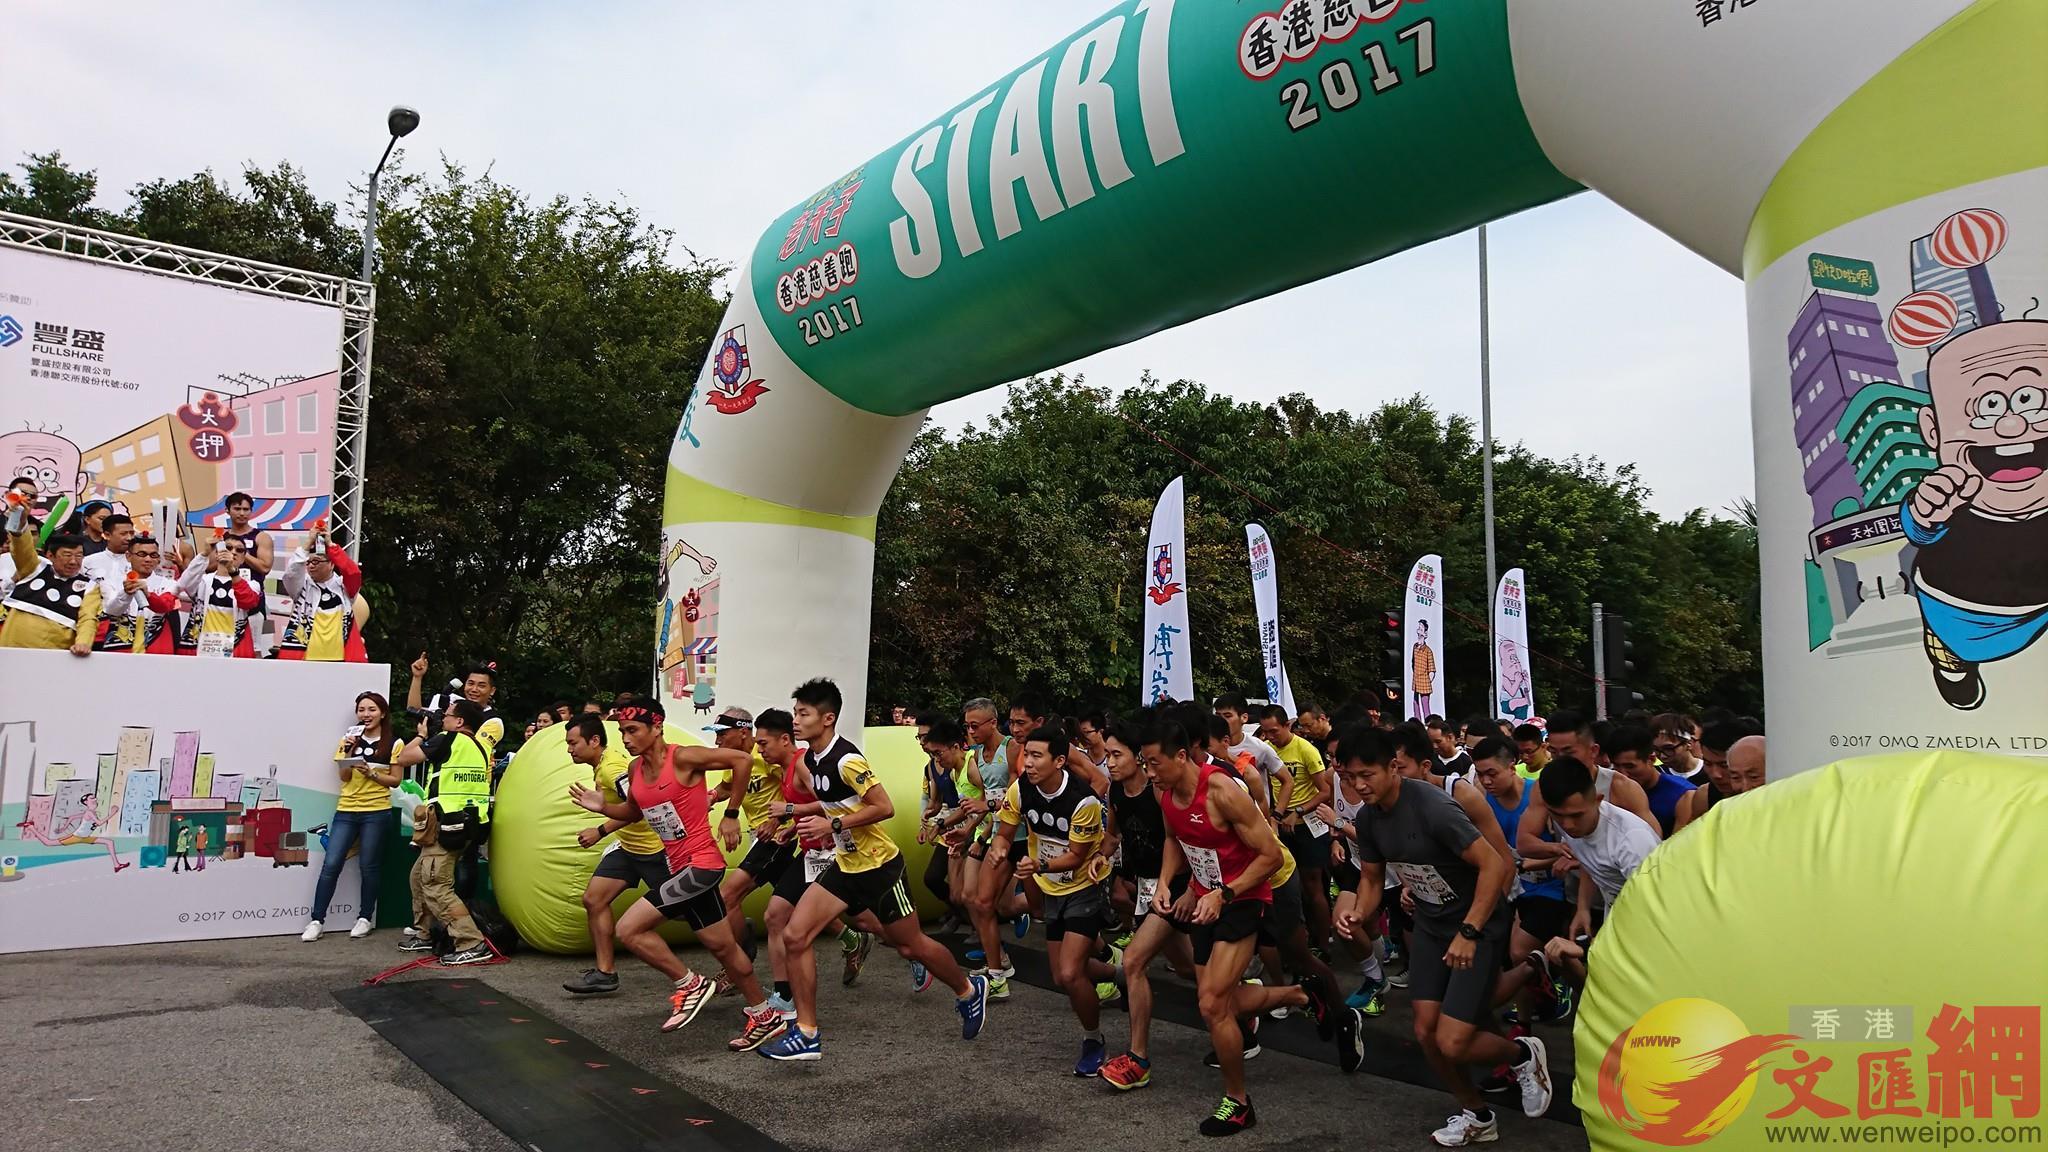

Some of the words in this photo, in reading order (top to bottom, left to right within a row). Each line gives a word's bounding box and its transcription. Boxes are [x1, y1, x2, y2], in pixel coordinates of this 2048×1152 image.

[1279, 16, 1437, 133] 2017
[889, 0, 1186, 279] START
[779, 248, 856, 308] 香港慈善跑
[33, 321, 106, 352] 豐盛
[798, 297, 864, 347] 2017
[31, 357, 111, 377] 豐盛控股有限公司
[32, 344, 105, 362] FULLSHARE
[1879, 736, 1919, 749] OMQ
[1925, 736, 2001, 749] ZMEDIA
[193, 911, 227, 922] 2017
[232, 908, 268, 920] OMQ
